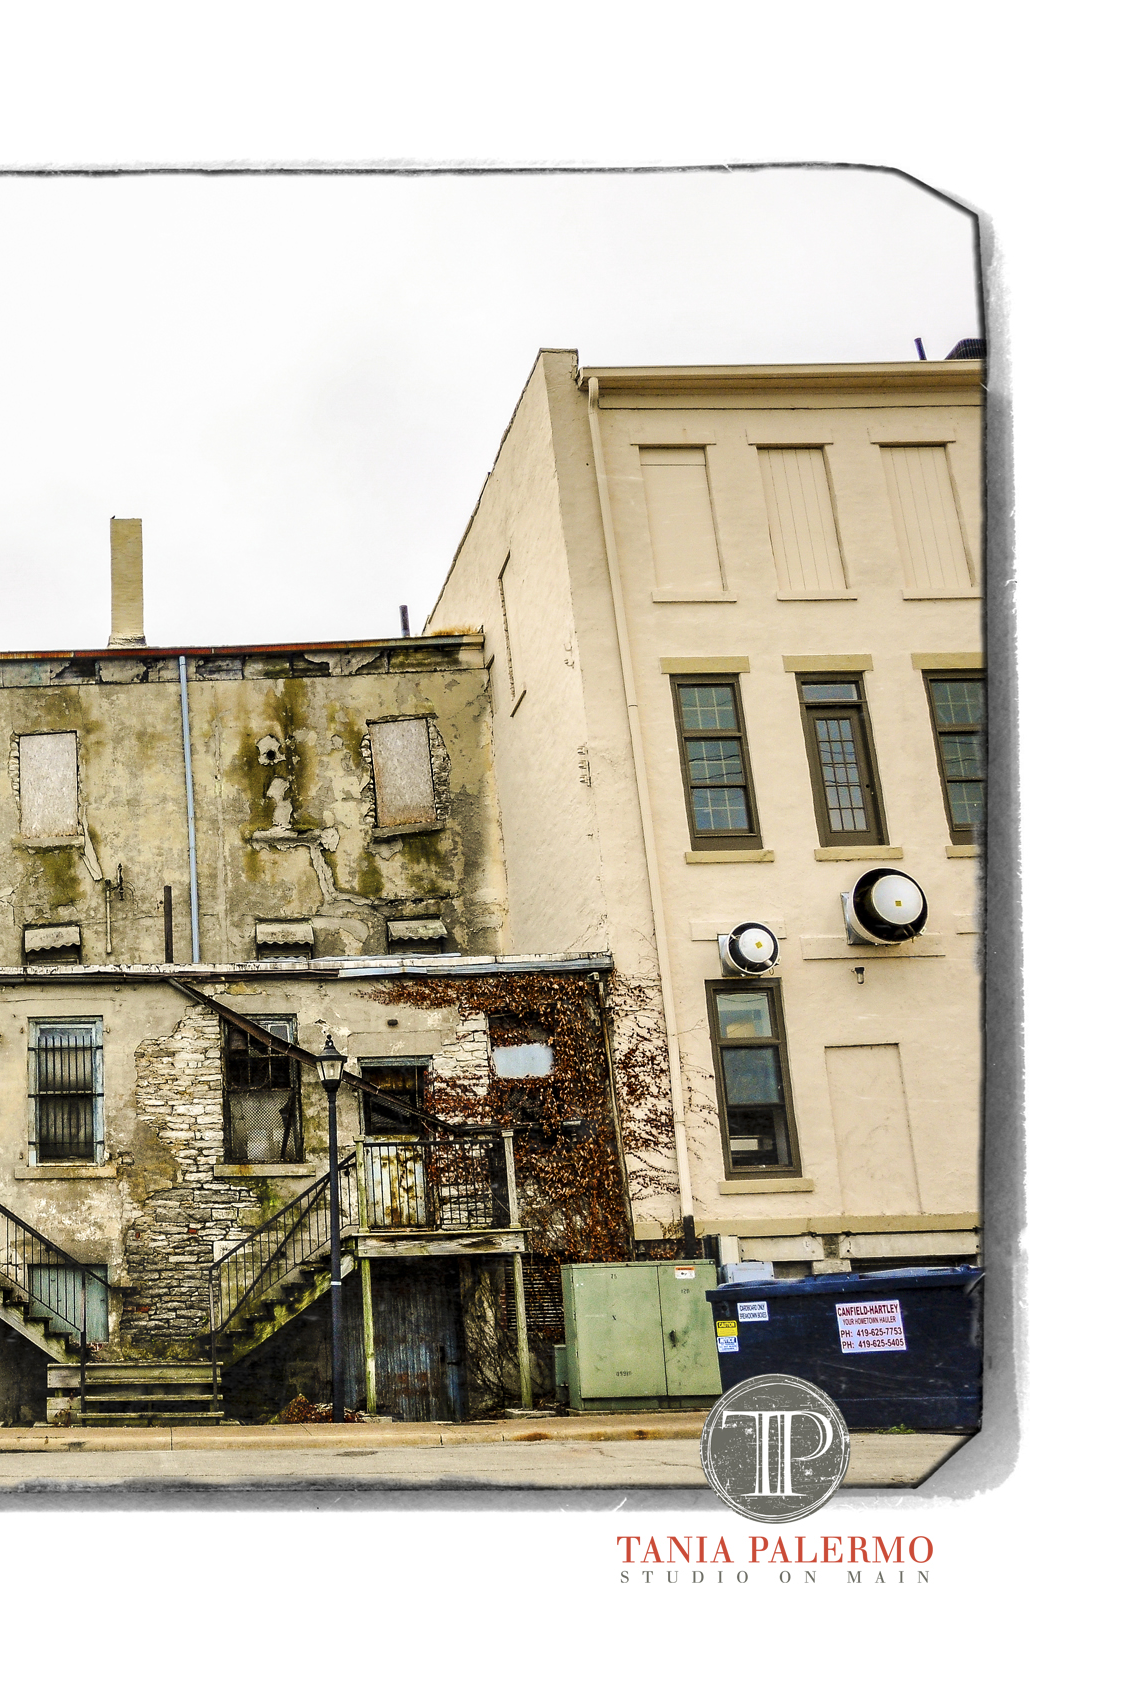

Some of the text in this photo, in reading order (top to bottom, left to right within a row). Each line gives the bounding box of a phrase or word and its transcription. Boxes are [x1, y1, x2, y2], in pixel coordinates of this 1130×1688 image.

[837, 1304, 898, 1316] CANFIELD-HARTLEY
[842, 1315, 897, 1326] YOUR HOMETOWN HAULER
[841, 1326, 903, 1339] PH: 419-625-7753
[842, 1338, 905, 1350] PH: 419-625-5405
